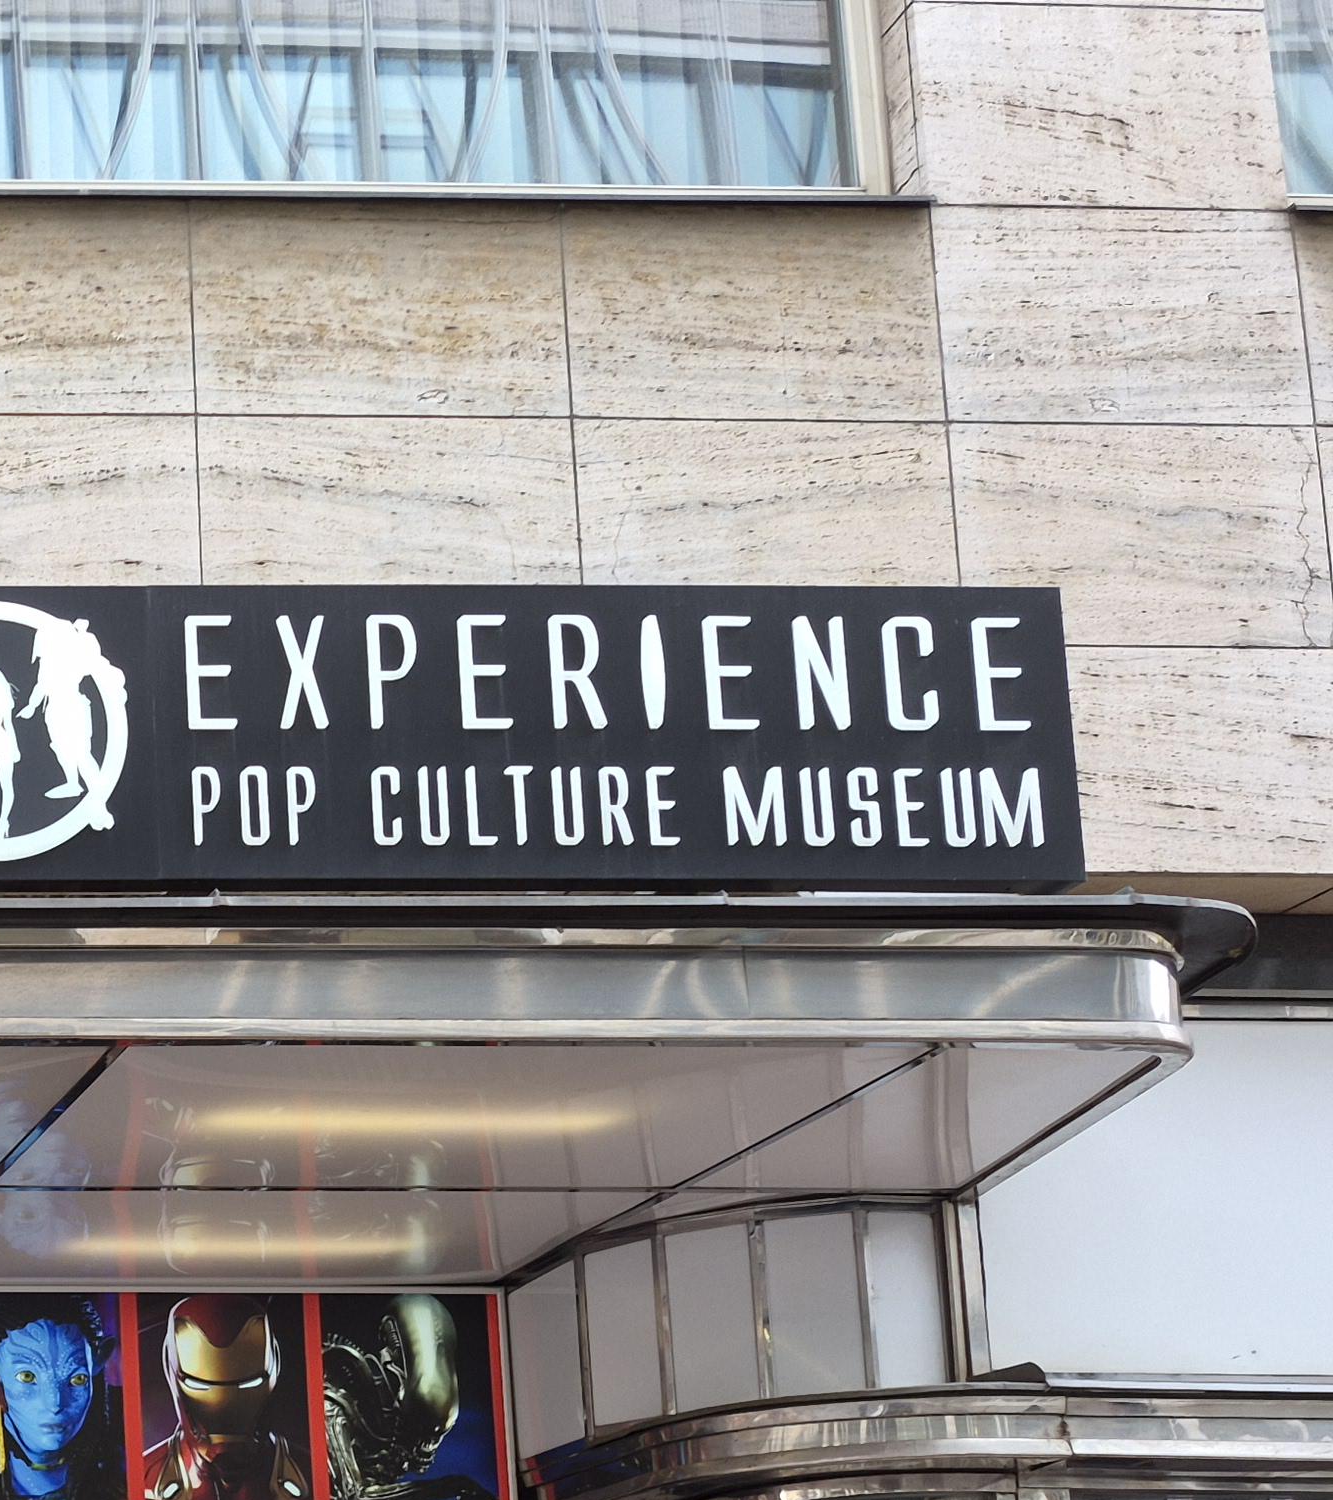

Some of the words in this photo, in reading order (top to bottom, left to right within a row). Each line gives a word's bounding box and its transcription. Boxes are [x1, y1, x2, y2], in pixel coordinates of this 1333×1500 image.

[184, 612, 1035, 732] EXPERIENCE
[190, 764, 319, 847] POP
[370, 764, 682, 848] CULTURE
[725, 765, 1047, 850] MUSEUM
